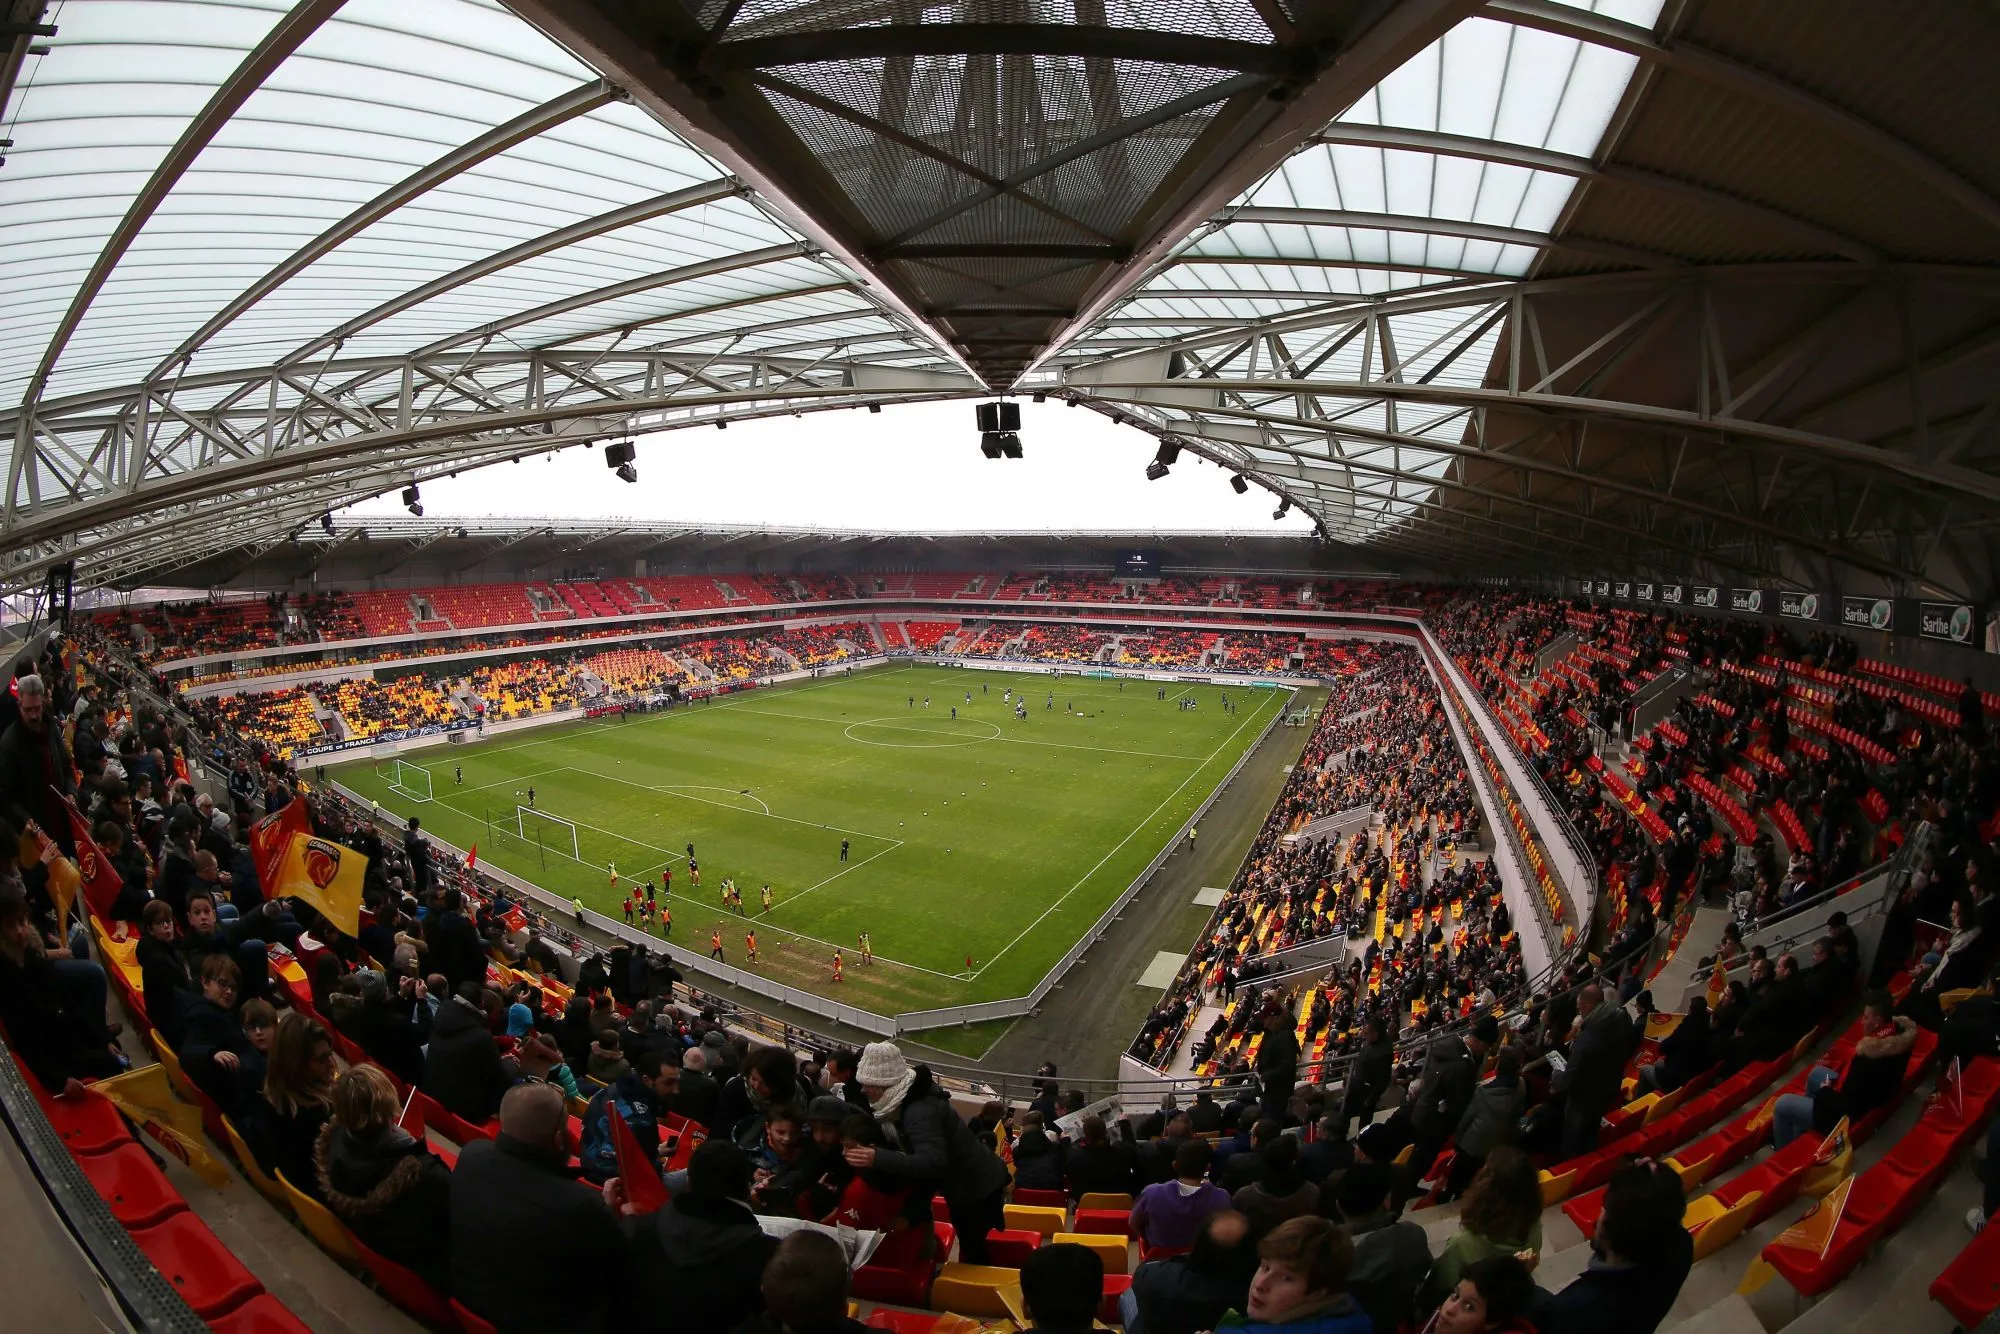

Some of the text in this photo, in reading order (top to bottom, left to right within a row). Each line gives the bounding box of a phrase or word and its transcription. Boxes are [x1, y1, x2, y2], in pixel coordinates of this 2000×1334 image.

[1694, 593, 1707, 604] Sarthe
[1733, 596, 1748, 608] Sarthe
[1781, 600, 1800, 614] Sarthe
[1844, 606, 1869, 623] Sarthe
[1922, 615, 1949, 635] Sarthe
[307, 745, 333, 755] COUPE
[345, 737, 376, 748] FRANCE
